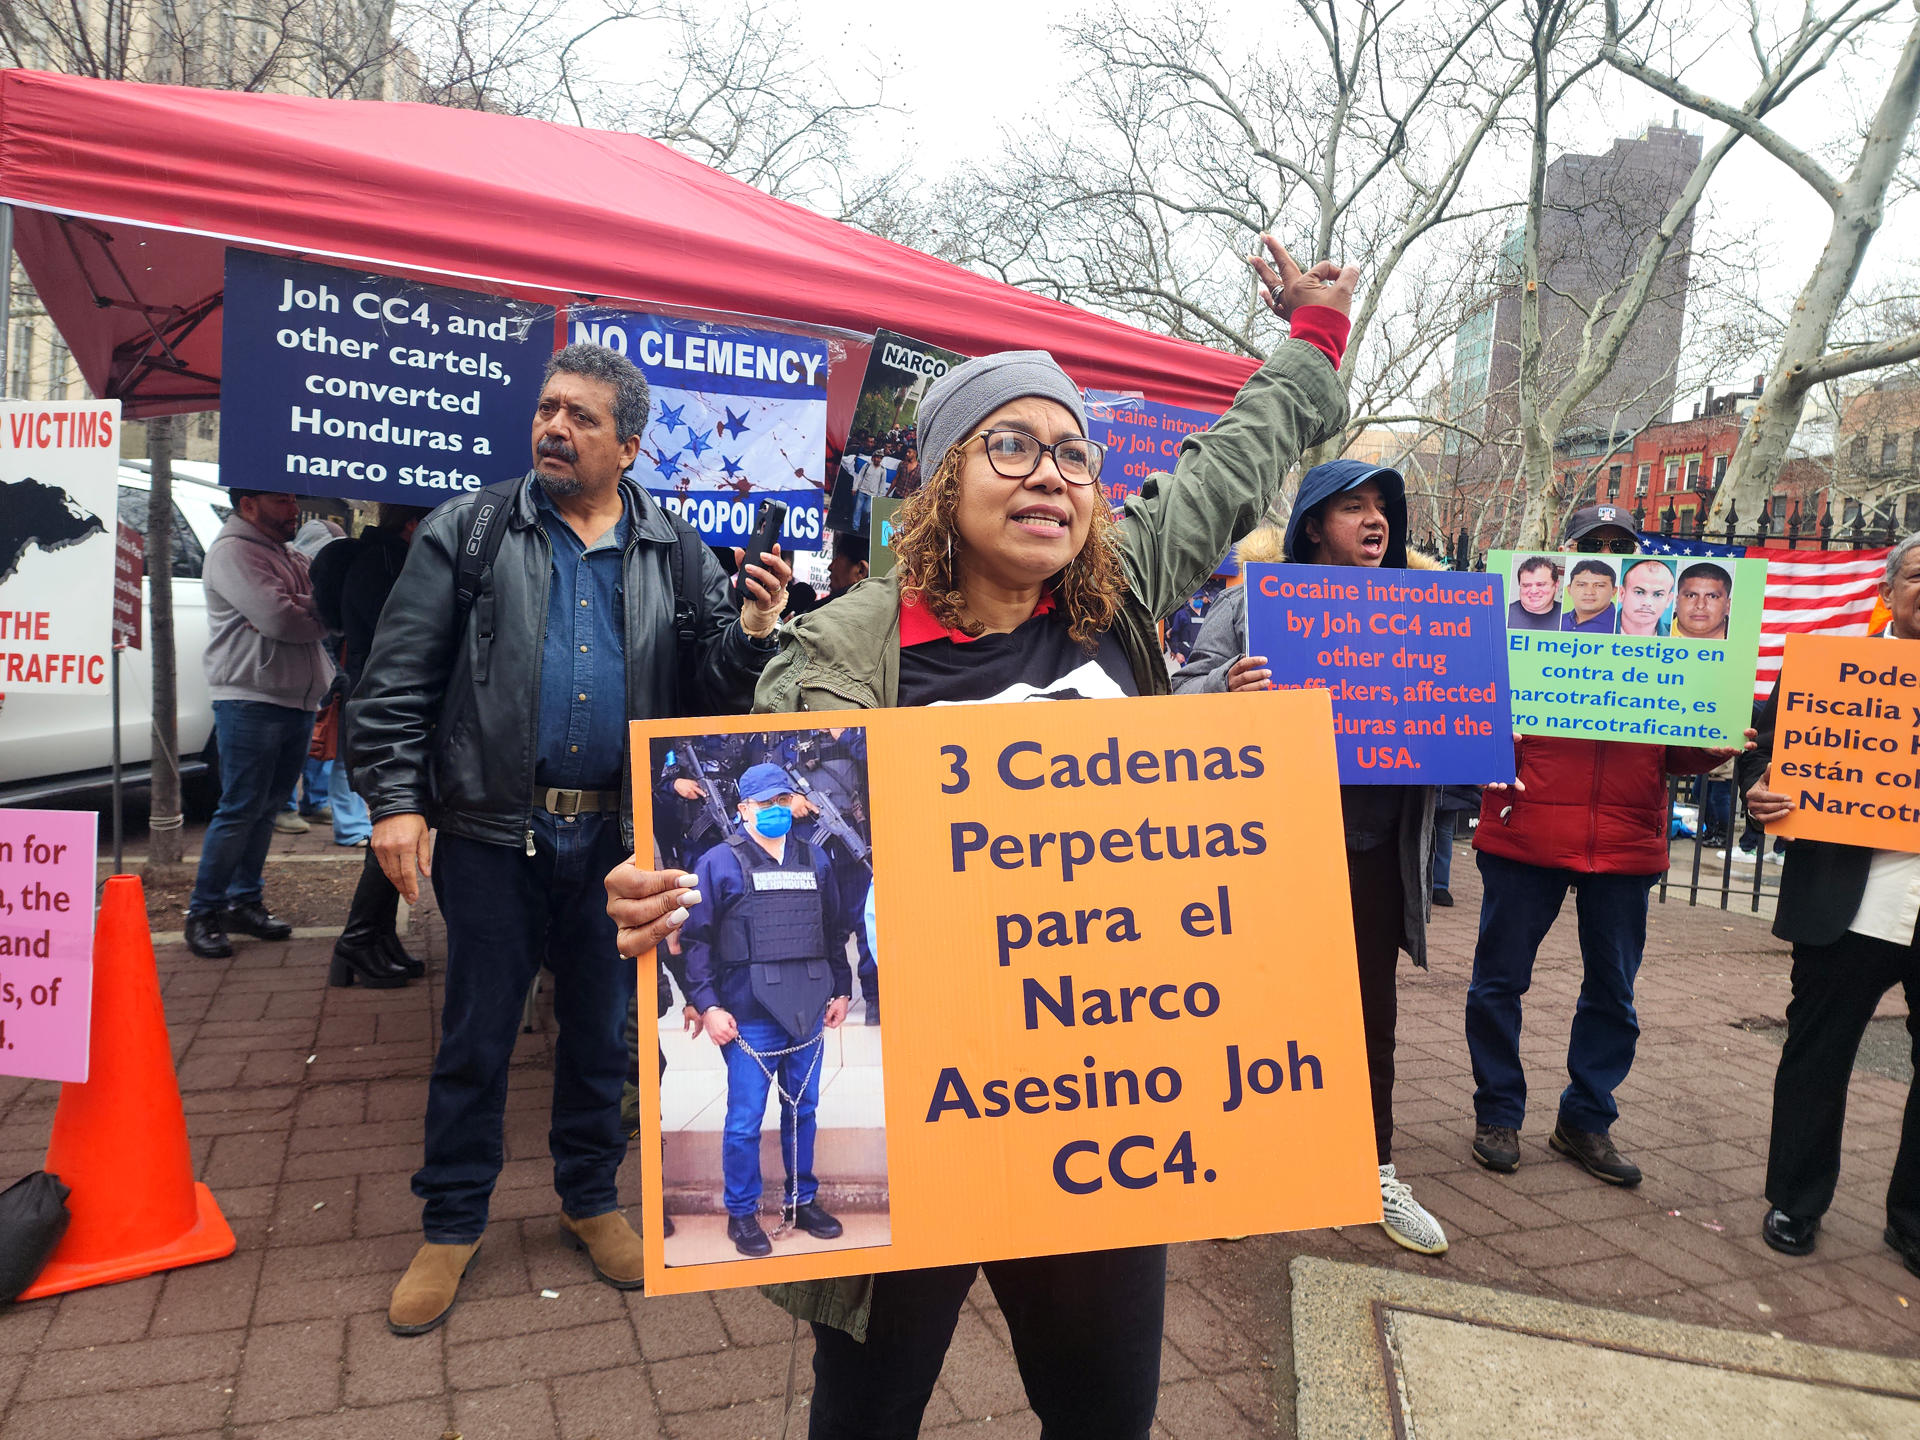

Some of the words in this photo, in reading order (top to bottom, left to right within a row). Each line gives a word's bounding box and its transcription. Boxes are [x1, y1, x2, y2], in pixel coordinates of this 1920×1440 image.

[278, 279, 340, 313] Joh
[352, 292, 440, 335] CC4,
[447, 315, 507, 341] and
[277, 327, 378, 360] other
[389, 346, 511, 386] cartels,
[639, 331, 822, 386] CLEMENCY
[883, 344, 948, 379] NARCO
[305, 374, 481, 415] converted
[10, 411, 113, 448] VICTIMS
[291, 406, 463, 452] Honduras
[473, 436, 492, 455] a
[1092, 400, 1158, 428] Cocaine
[1162, 413, 1209, 434] introd
[1107, 430, 1126, 453] by
[1129, 434, 1156, 454] Joh
[286, 453, 388, 482] narco
[398, 464, 482, 492] state
[1259, 576, 1359, 601] Cocaine
[1367, 580, 1493, 606] introduced
[0, 611, 50, 640] THE
[1287, 610, 1315, 638] by
[1321, 612, 1361, 638] Joh
[1369, 614, 1421, 636] CC4
[1429, 617, 1471, 637] and
[1317, 646, 1384, 668] other
[1392, 648, 1447, 675] drug
[1509, 635, 1530, 651] El
[1537, 639, 1604, 658] mejor
[1611, 642, 1689, 664] testigo
[1697, 649, 1725, 662] en
[1541, 665, 1614, 681] contra
[1622, 667, 1649, 683] de
[1657, 672, 1685, 685] un
[1839, 662, 1920, 688] Pode
[1403, 681, 1496, 703] affected
[1510, 688, 1687, 714] narcotraficante,
[1693, 700, 1717, 713] es
[1786, 691, 1902, 720] Fiscalia
[1333, 713, 1396, 735] duras
[1404, 714, 1446, 736] and
[1454, 715, 1493, 736] the
[1546, 713, 1728, 740] narcotraficante.
[1783, 726, 1899, 754] público
[940, 744, 971, 795] 3
[997, 737, 1265, 790] Cadenas
[1357, 747, 1421, 769] USA.
[1780, 761, 1864, 784] están
[24, 834, 67, 864] for
[950, 817, 1267, 882] Perpetuas
[21, 881, 70, 912] the
[996, 904, 1141, 967] para
[1180, 885, 1232, 938] el
[30, 977, 62, 1006] of
[1022, 975, 1221, 1030] Narco
[925, 1055, 1183, 1123] Asesino
[1223, 1040, 1324, 1112] Joh
[1052, 1130, 1217, 1195] CC4.
